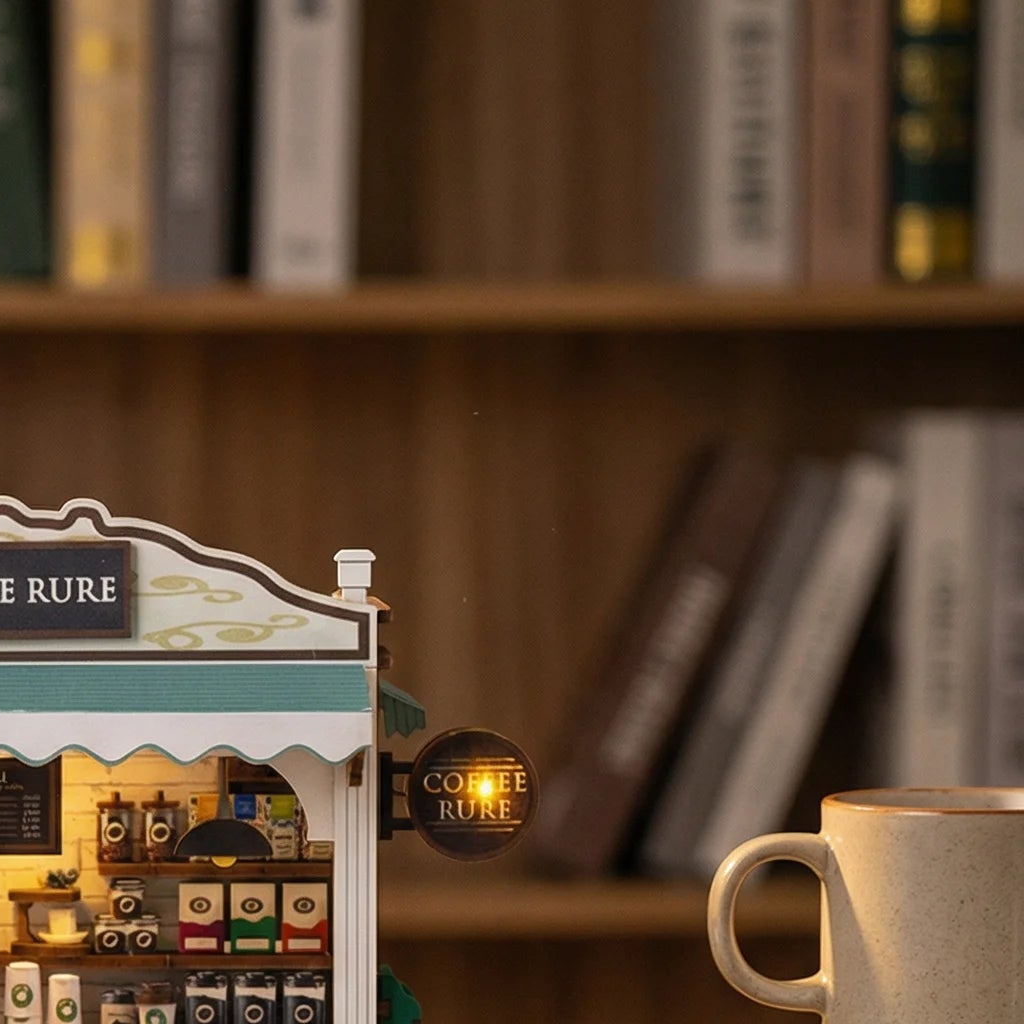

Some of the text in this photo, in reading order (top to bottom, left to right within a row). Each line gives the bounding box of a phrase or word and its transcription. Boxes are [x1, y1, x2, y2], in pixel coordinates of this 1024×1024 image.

[26, 576, 118, 604] RURE
[423, 771, 527, 794] COFFEE
[438, 799, 512, 820] RURE
